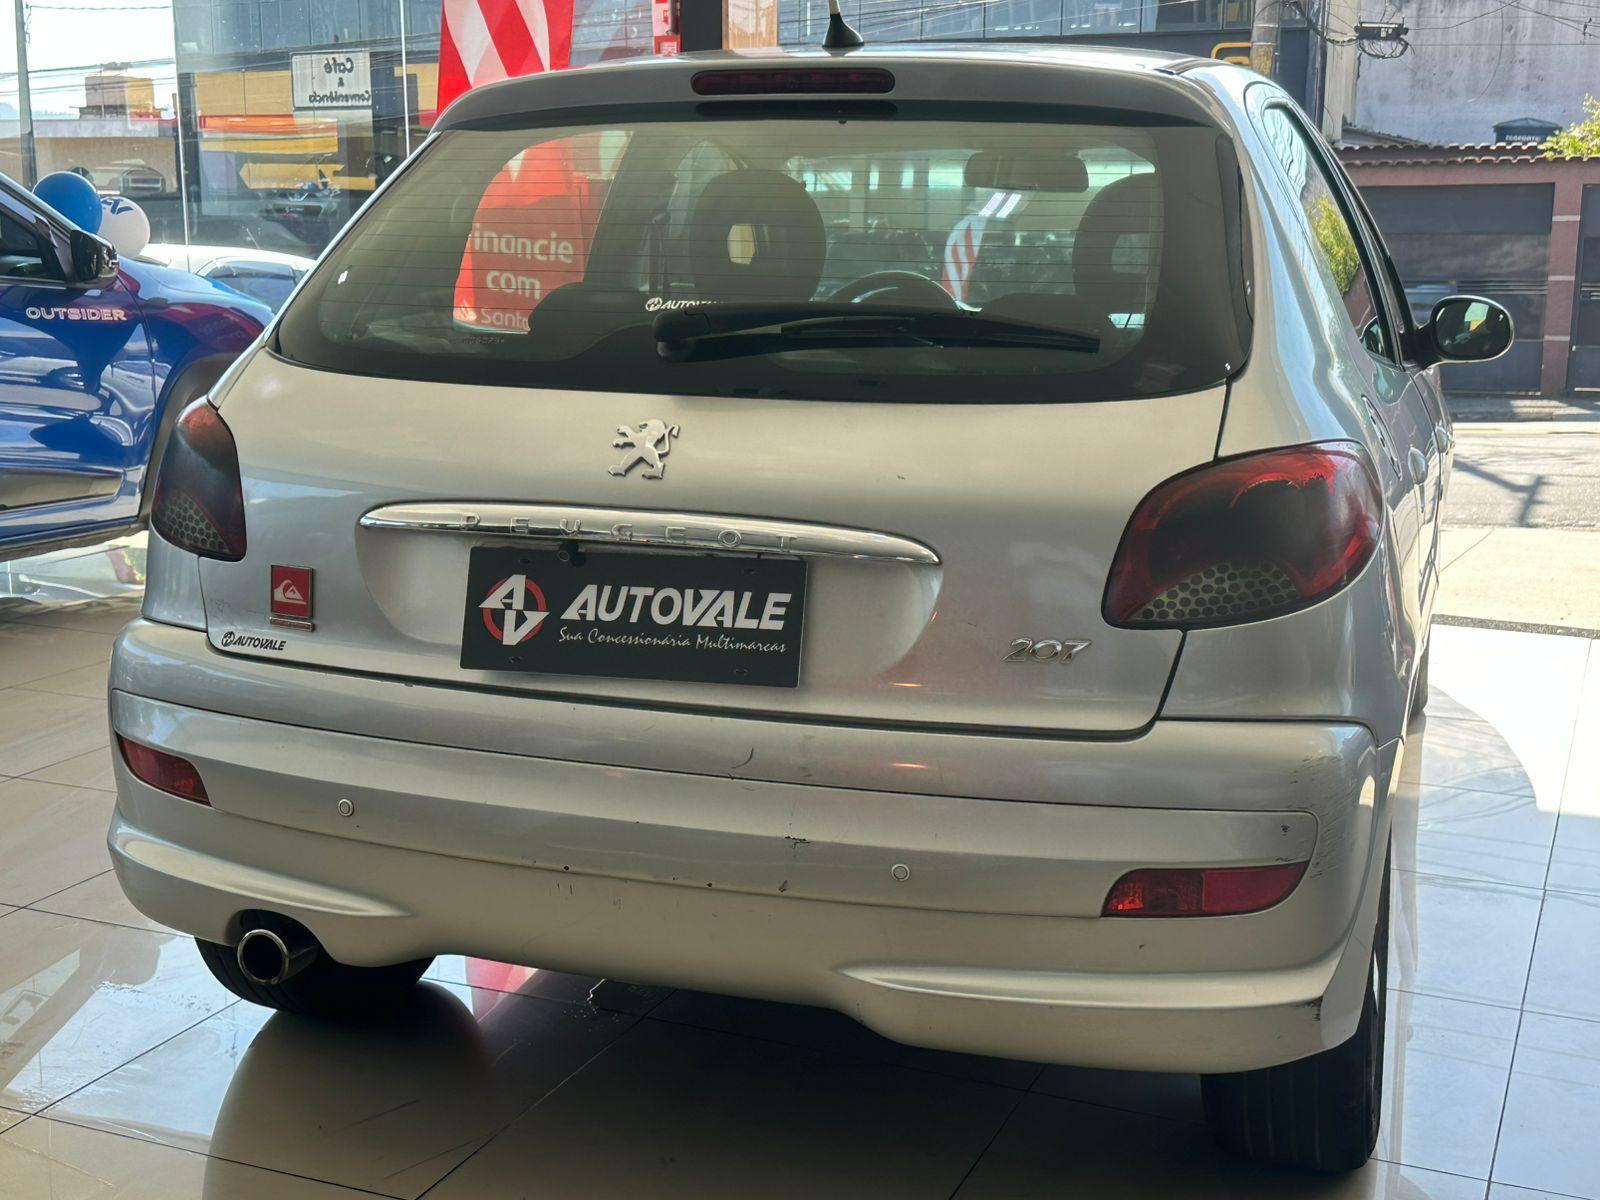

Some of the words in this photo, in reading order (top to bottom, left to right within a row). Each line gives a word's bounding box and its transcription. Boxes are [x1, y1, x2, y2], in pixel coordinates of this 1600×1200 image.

[473, 222, 574, 264] inancie
[485, 270, 541, 300] com
[25, 307, 127, 321] OUTSIDER
[480, 307, 529, 331] Santa
[460, 513, 798, 553] PEUGEOT
[560, 584, 792, 631] AUTOVALE
[234, 635, 287, 651] AUTOVALE
[558, 626, 583, 642] Sua
[588, 628, 691, 647] Concessionária
[695, 634, 787, 653] Multimarcas
[1001, 637, 1093, 665] 207
